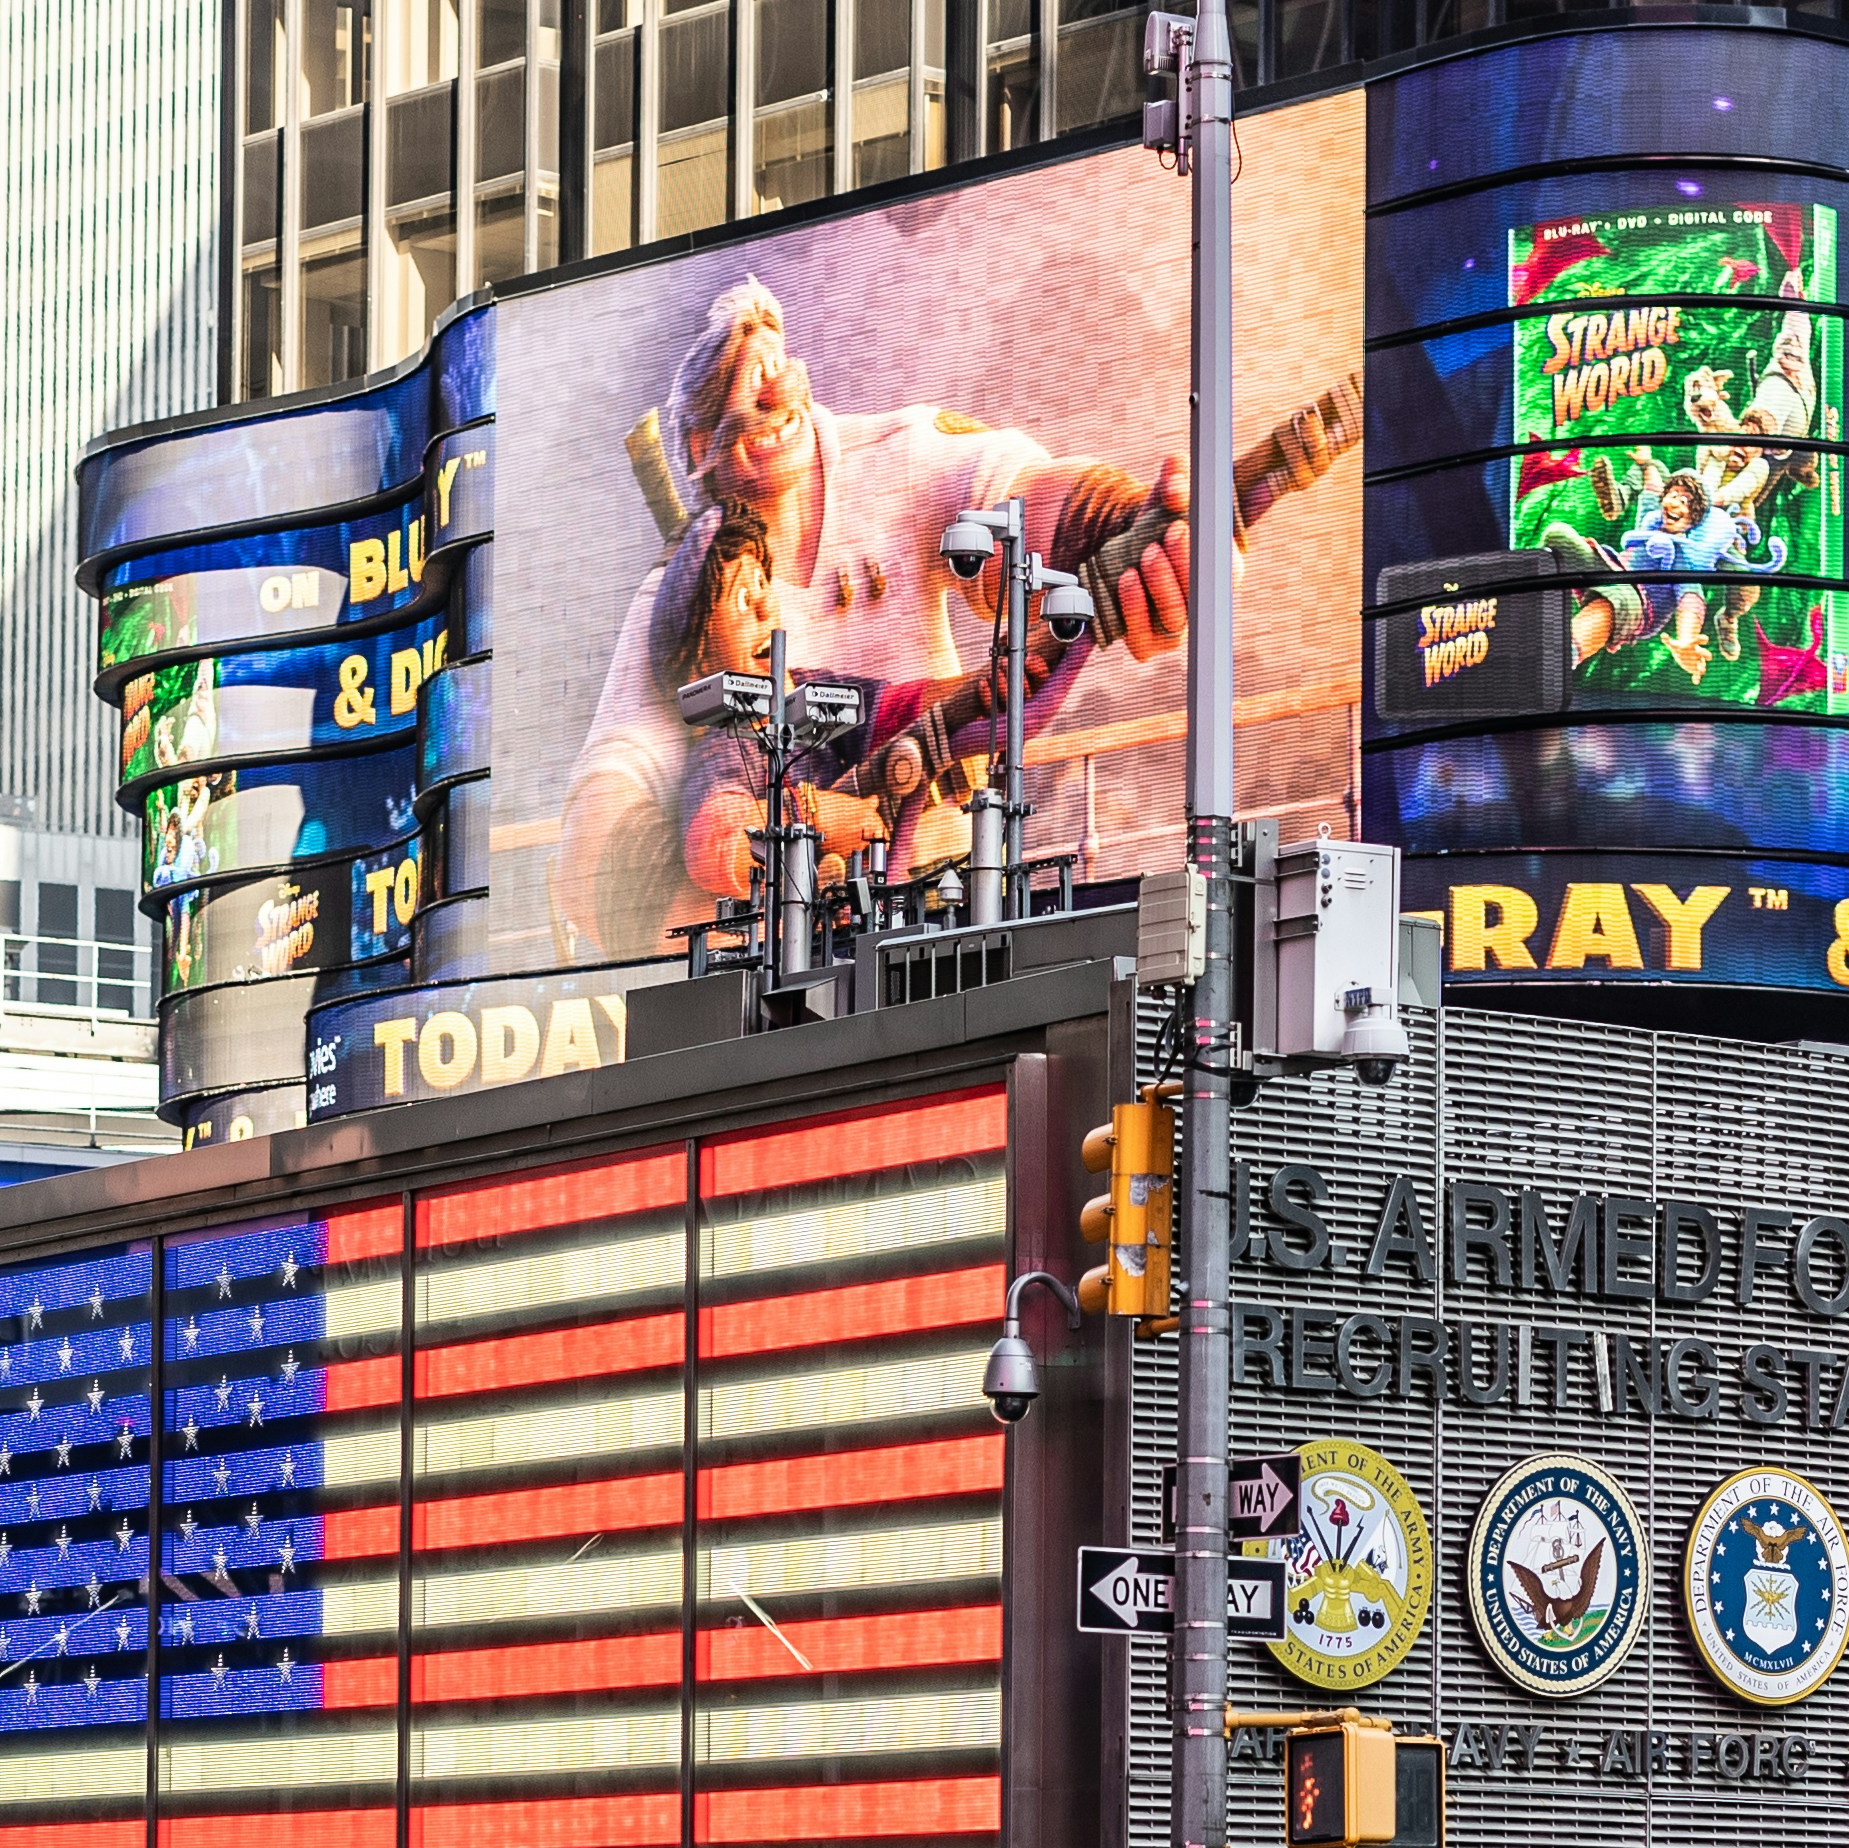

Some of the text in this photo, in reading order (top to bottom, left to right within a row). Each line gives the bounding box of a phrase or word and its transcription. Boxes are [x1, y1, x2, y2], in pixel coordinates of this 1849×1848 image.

[1617, 215, 1647, 231] DVD
[1668, 210, 1726, 226] DIGITAL
[1733, 210, 1772, 224] CODE
[1542, 307, 1682, 374] STRANGE
[1554, 347, 1667, 427] WORLD
[259, 571, 320, 613] ON
[1418, 598, 1498, 648] STRANGE
[1424, 631, 1489, 688] WORLD
[333, 654, 376, 729] &
[1364, 1174, 1722, 1300] ARMED
[1231, 1303, 1720, 1419] RECRUITING
[1238, 1482, 1280, 1515] WAY
[1348, 1454, 1426, 1569] OF THE ARMY
[1487, 1477, 1633, 1566] DEPARTMENT OF THE NAVY
[1693, 1477, 1849, 1636] DEPARTMENT OF THE AIR FORCE
[1112, 1576, 1260, 1614] ONE AY
[1284, 1585, 1424, 1679] STATES OF AMERICA
[1319, 1634, 1353, 1649] 1775
[1486, 1587, 1633, 1675] UNITED STATES OF AMERICA
[1706, 1632, 1831, 1691] UNITED STATES OF AMERICA
[1743, 1651, 1795, 1670] MCMXLVII
[1601, 1730, 1669, 1778] AIR
